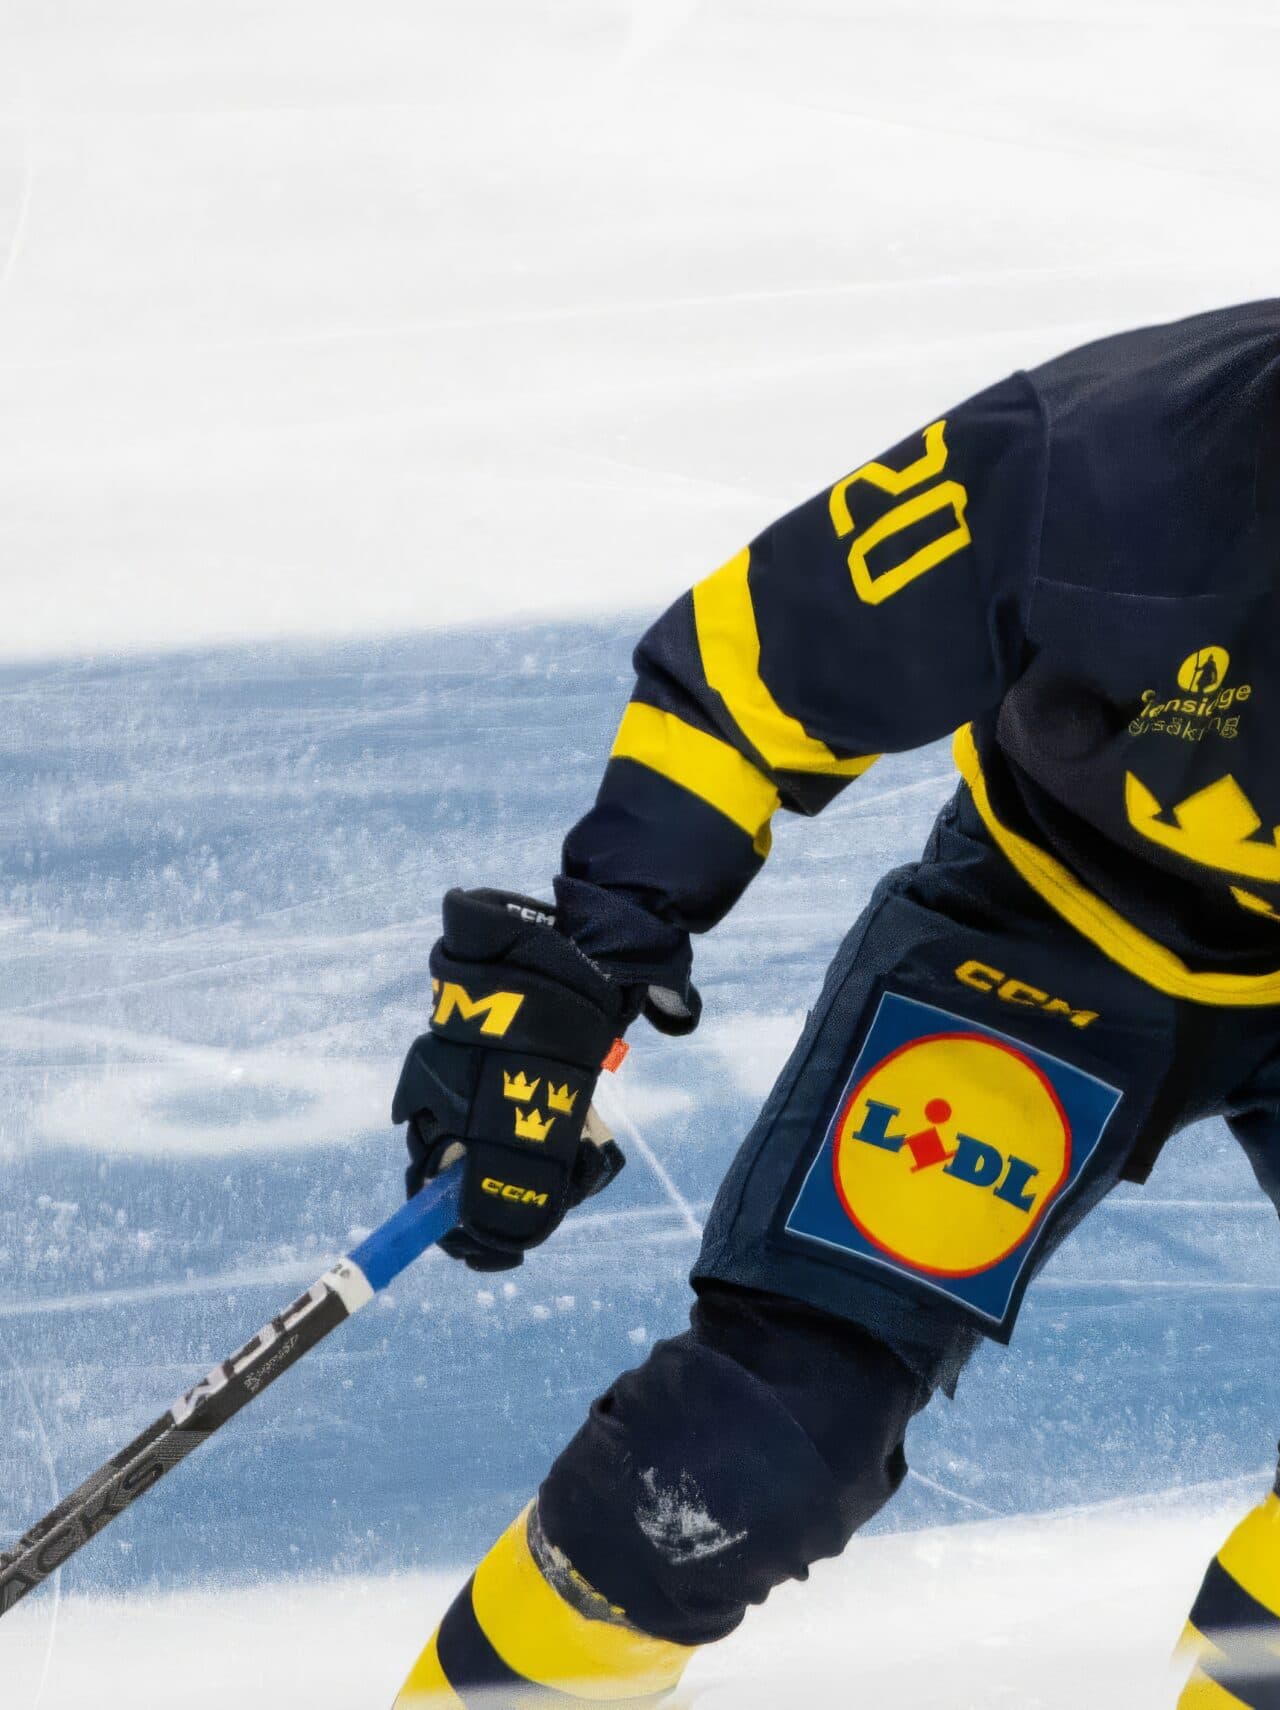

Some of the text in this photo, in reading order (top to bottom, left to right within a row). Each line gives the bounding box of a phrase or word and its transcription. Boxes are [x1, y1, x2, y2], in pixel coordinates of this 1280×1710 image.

[829, 419, 972, 606] 20
[955, 959, 1099, 1028] CCM
[481, 1177, 549, 1207] CCM
